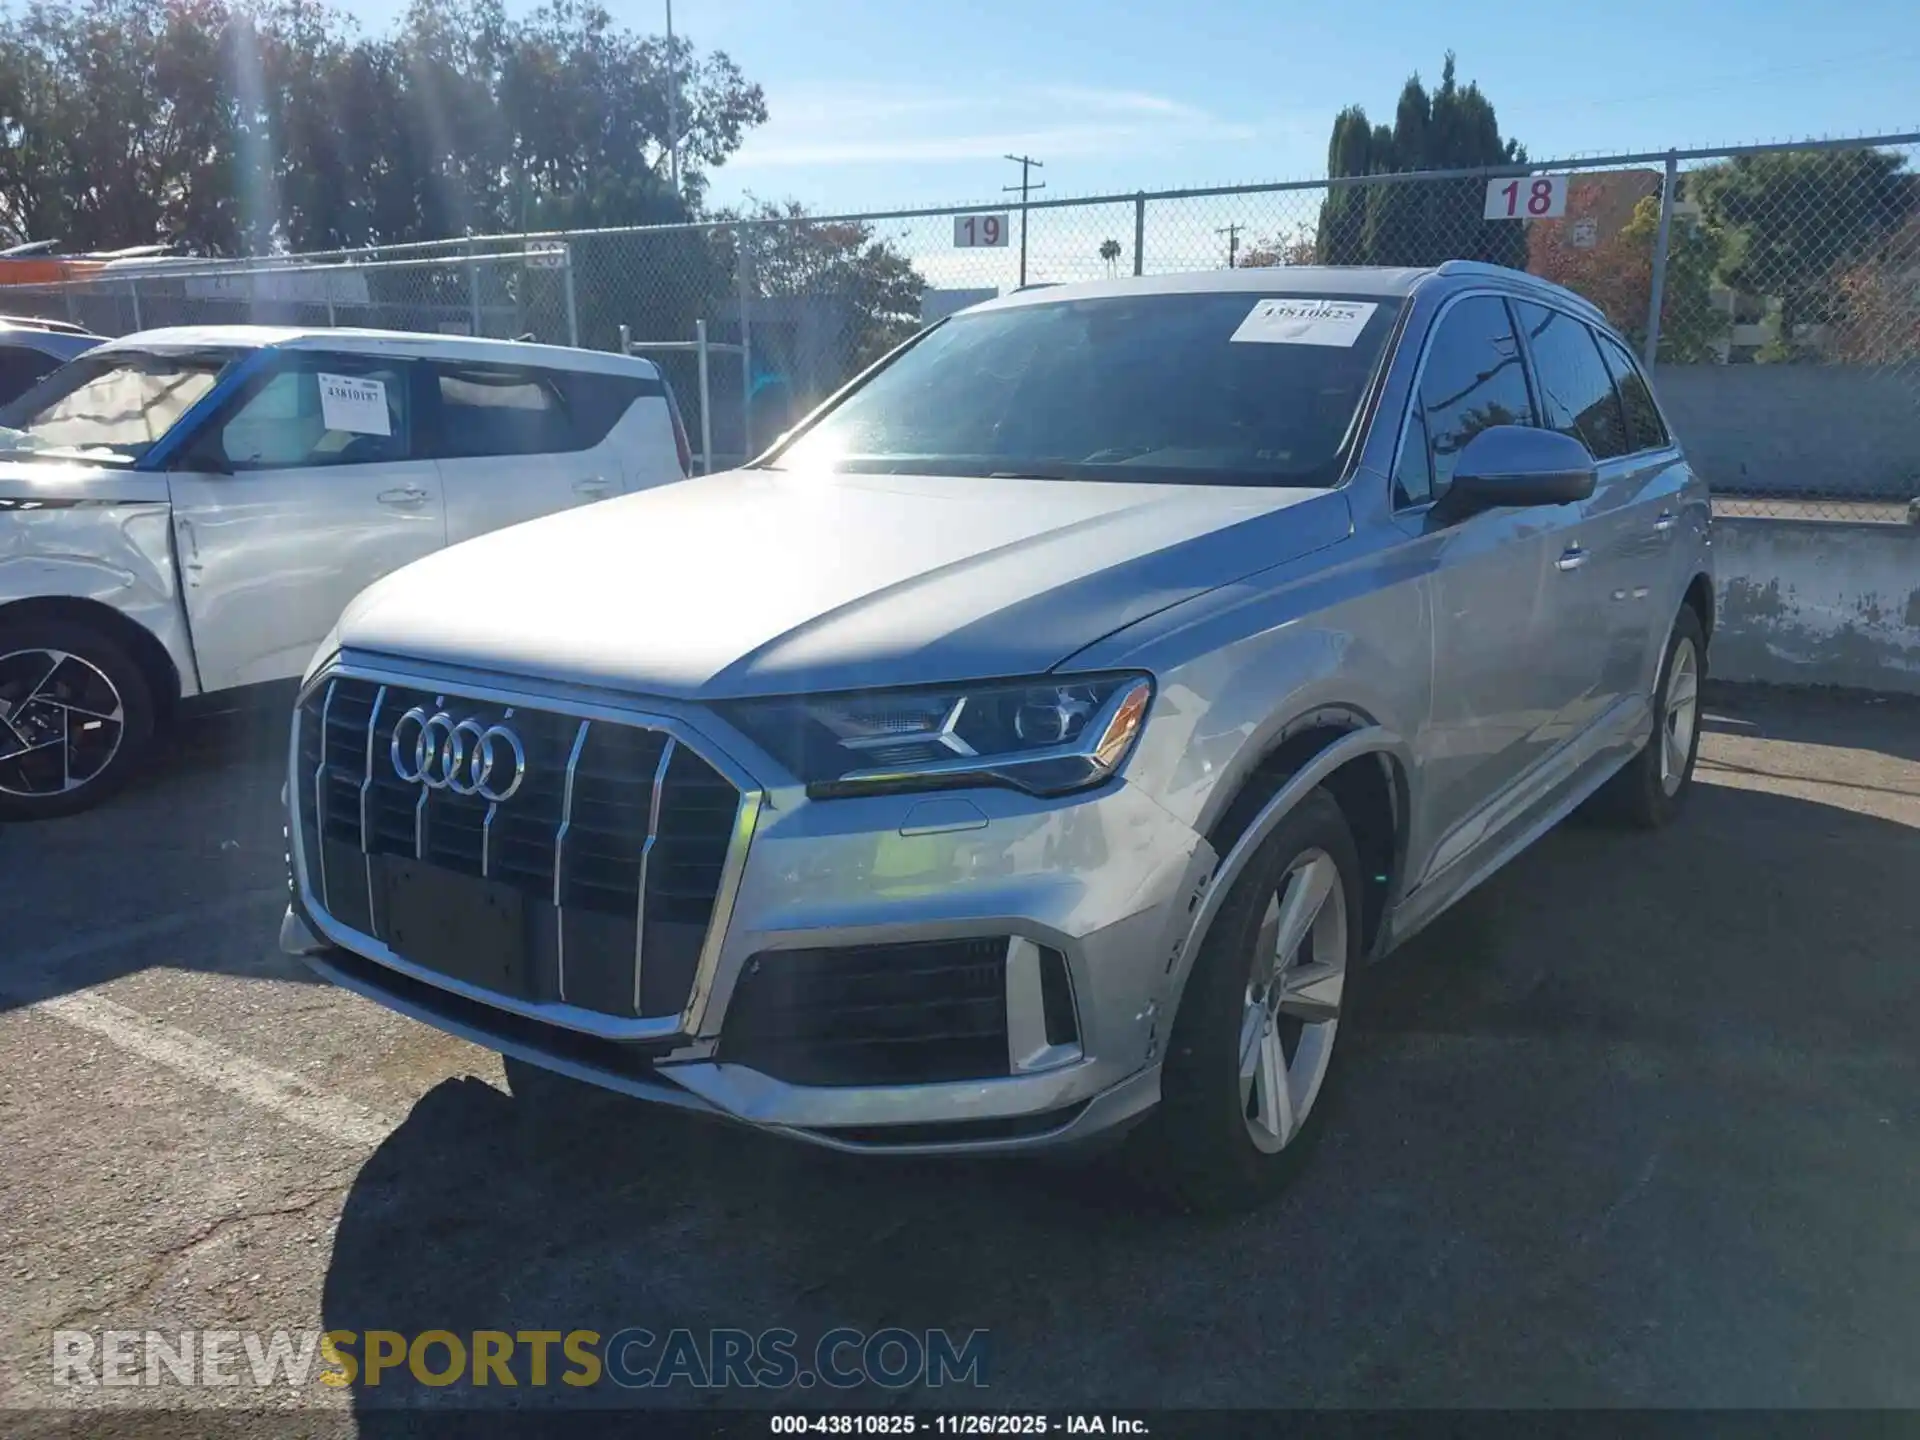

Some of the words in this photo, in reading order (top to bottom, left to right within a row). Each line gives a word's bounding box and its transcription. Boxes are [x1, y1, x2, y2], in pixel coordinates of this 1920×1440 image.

[1501, 180, 1552, 216] 18
[964, 215, 999, 246] 19
[1264, 307, 1356, 319] 43810825
